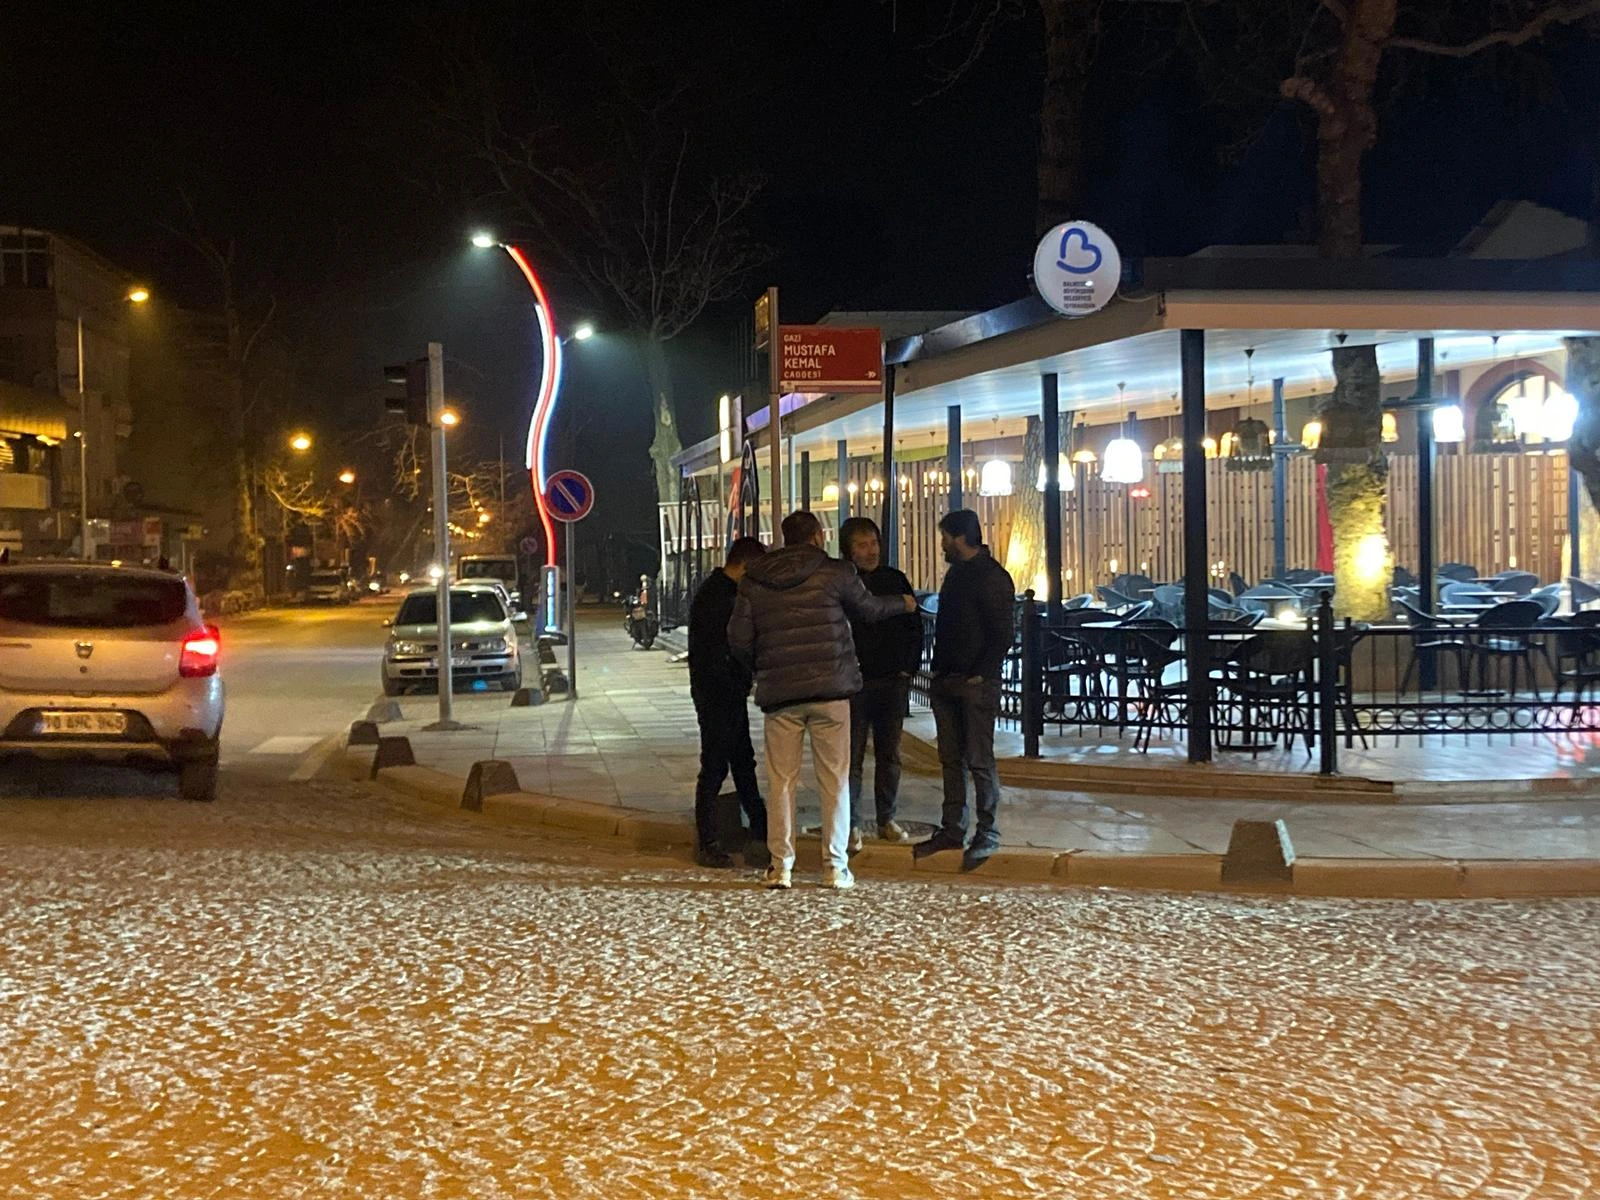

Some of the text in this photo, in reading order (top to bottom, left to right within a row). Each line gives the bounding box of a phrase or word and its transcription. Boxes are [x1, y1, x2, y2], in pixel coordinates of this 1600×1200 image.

[783, 334, 801, 342] GAZİ
[784, 344, 836, 356] MUSTAFA
[784, 358, 822, 368] KEMAL
[783, 370, 821, 378] CADDESİ
